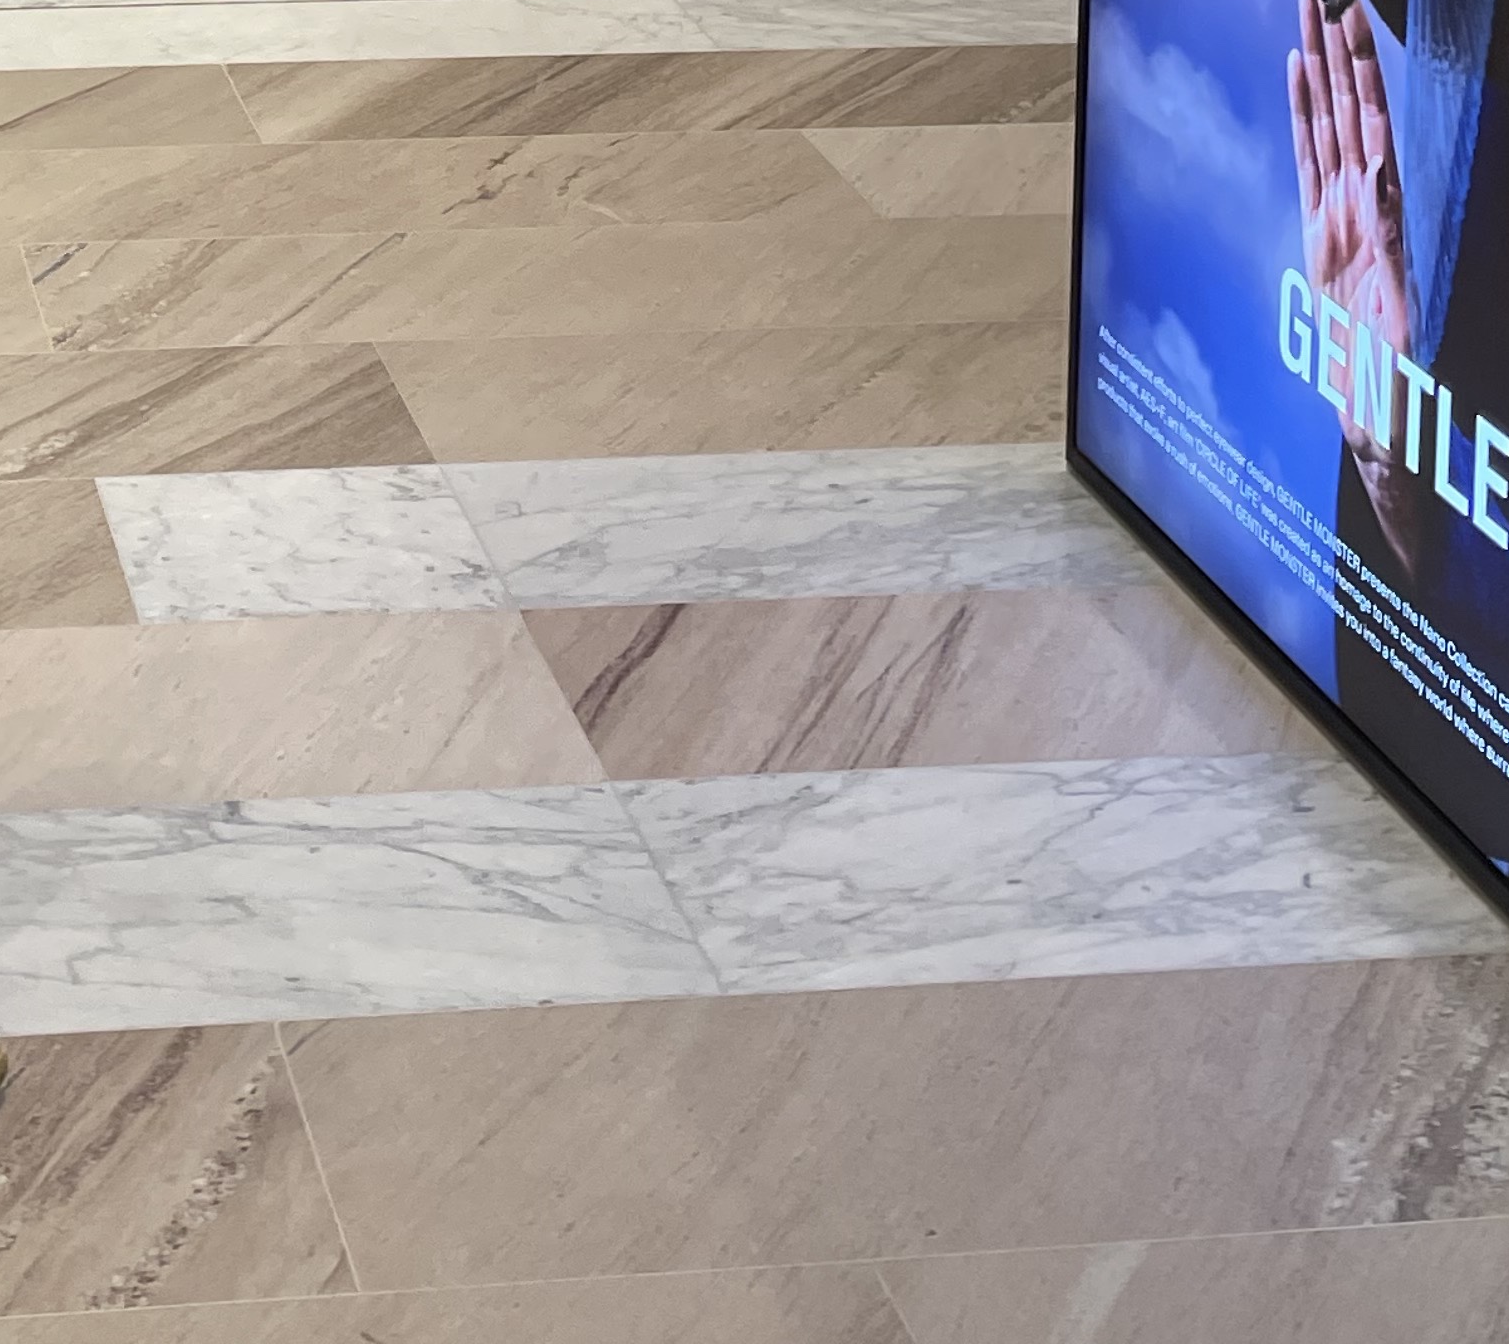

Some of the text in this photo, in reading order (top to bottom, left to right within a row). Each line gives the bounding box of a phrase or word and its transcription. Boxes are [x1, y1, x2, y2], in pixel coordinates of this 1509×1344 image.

[1279, 268, 1509, 551] GENTLE
[1313, 517, 1361, 574] MONSTER
[1361, 566, 1402, 611] presents
[1402, 601, 1418, 627] the
[1447, 641, 1498, 700] Collection
[1335, 568, 1372, 614] homage
[1372, 604, 1383, 624] to
[1383, 614, 1400, 639] the
[1400, 632, 1449, 689] continuity
[1477, 704, 1509, 744] where
[1345, 610, 1363, 635] you
[1389, 648, 1425, 697] fantasy
[1424, 685, 1453, 722] world
[1453, 713, 1486, 753] where
